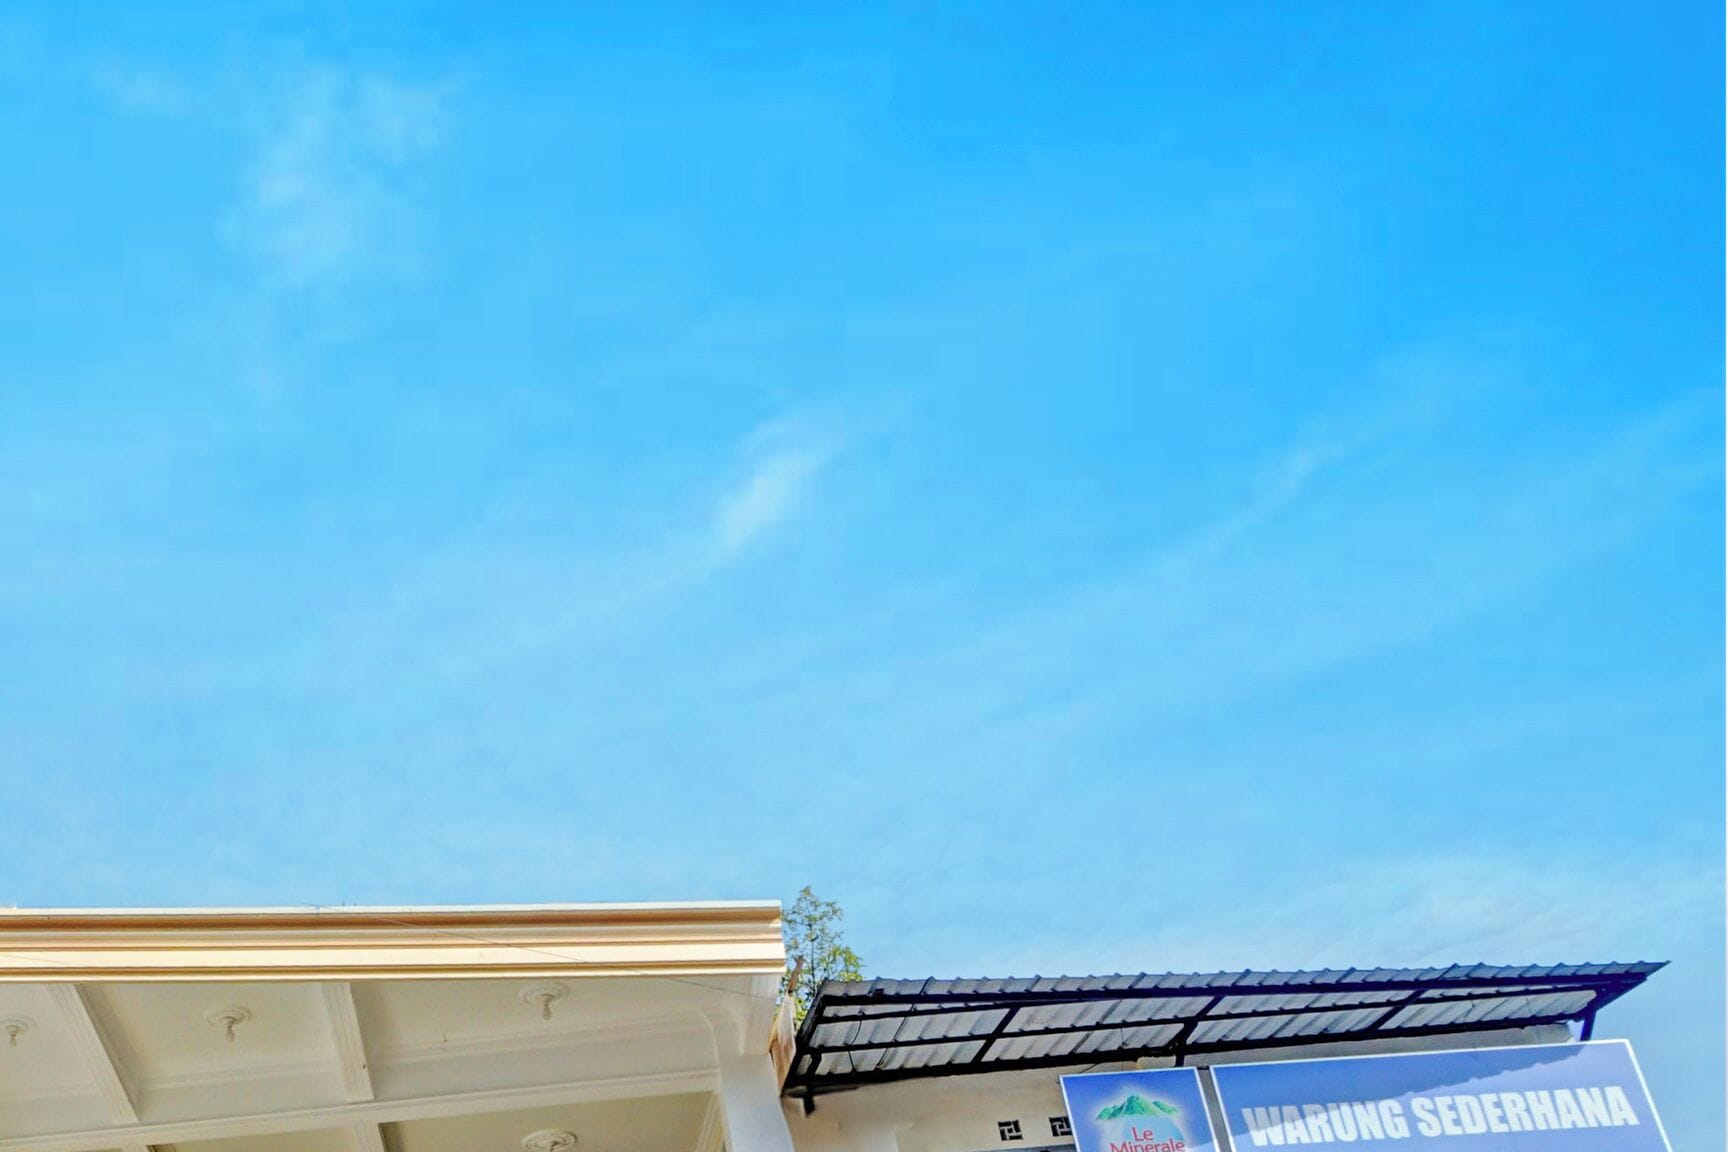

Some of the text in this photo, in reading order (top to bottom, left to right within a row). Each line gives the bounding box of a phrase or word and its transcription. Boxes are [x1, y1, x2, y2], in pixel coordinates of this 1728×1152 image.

[1131, 1127, 1154, 1141] Le
[1241, 1085, 1640, 1147] WARUNG SEDERHANA
